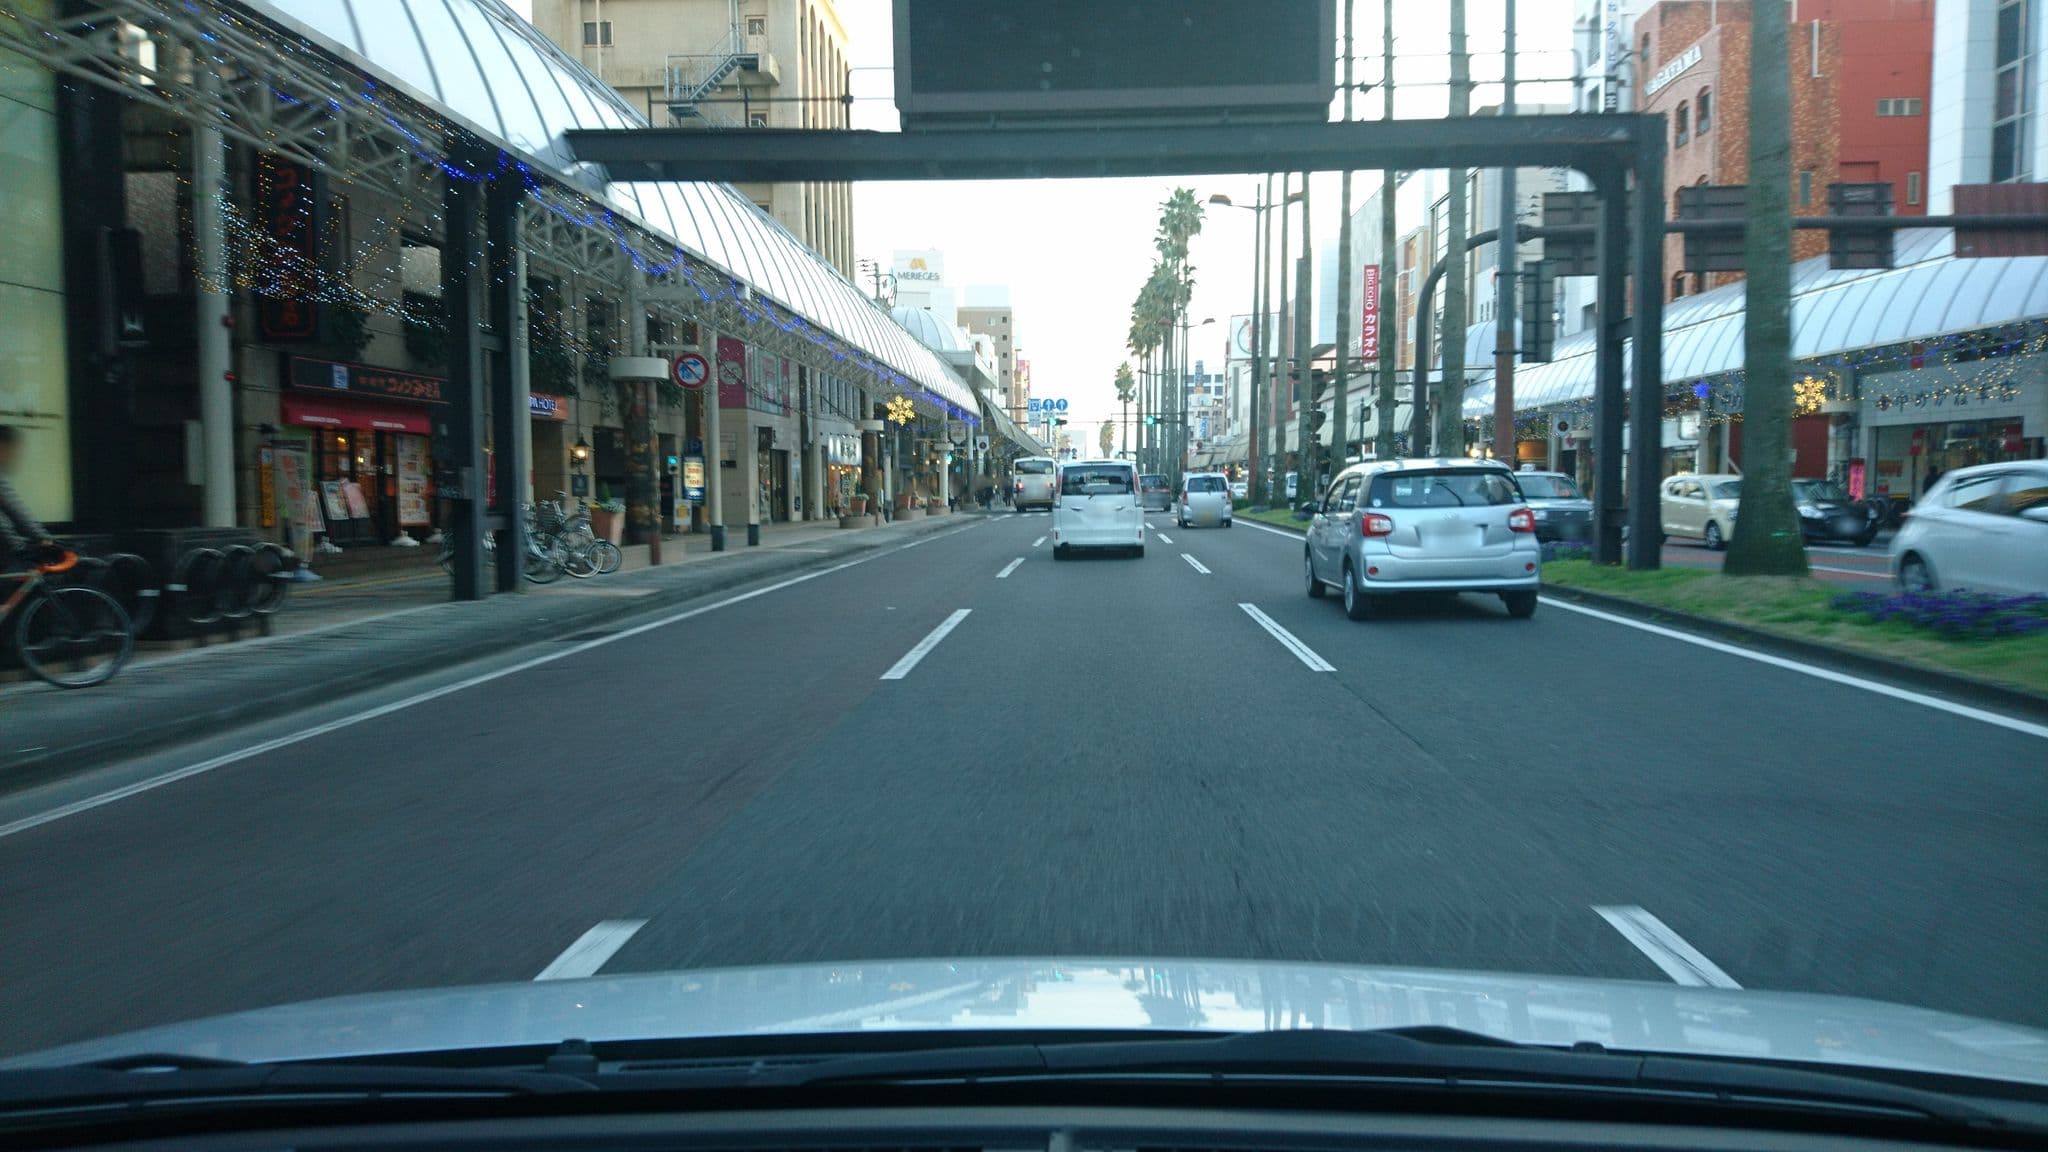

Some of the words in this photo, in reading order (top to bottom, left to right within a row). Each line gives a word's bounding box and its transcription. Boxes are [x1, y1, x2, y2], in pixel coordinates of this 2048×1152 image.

[1364, 312, 1376, 357] カラオケ
[538, 397, 559, 410] HOTEL
